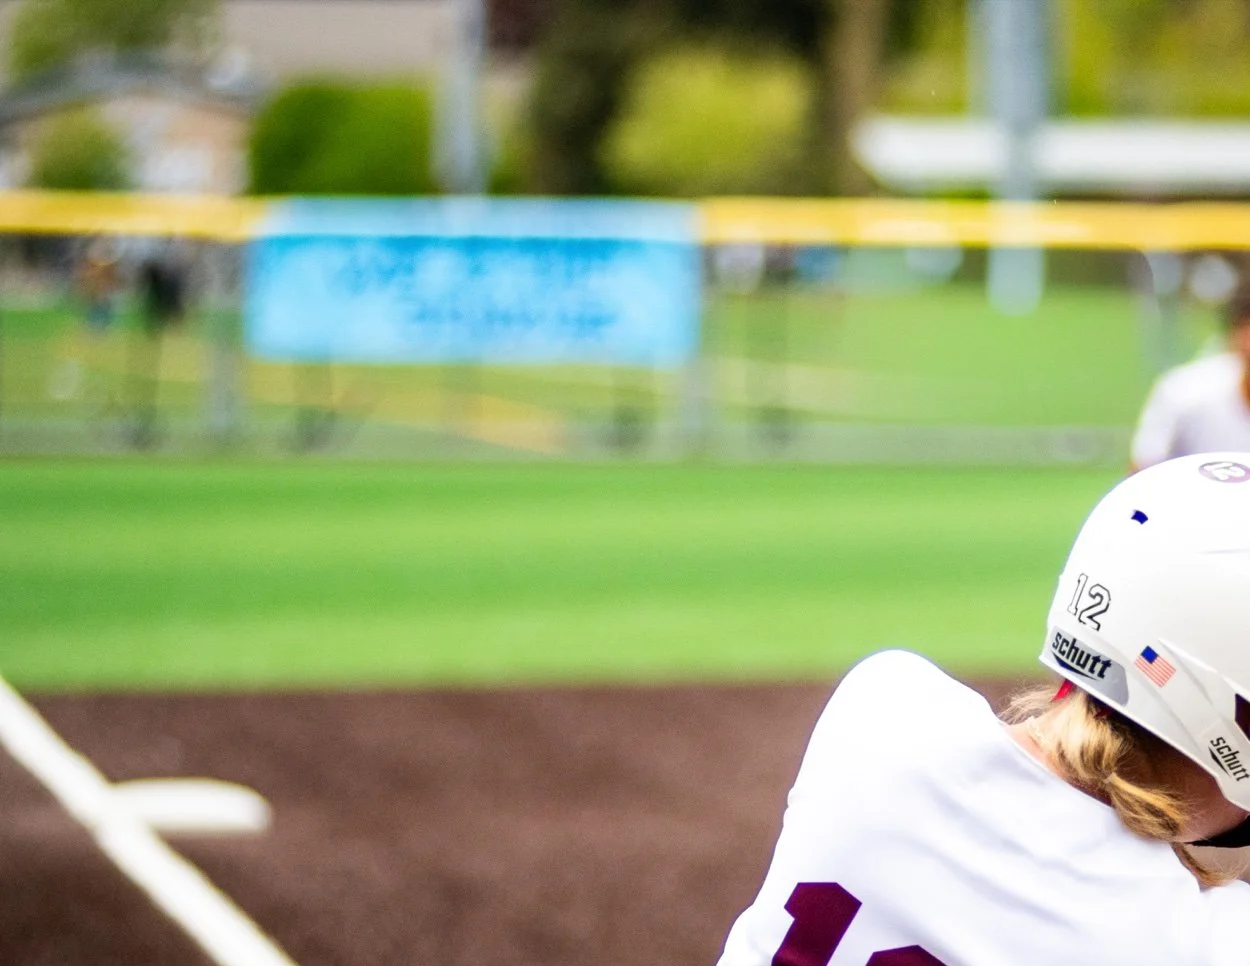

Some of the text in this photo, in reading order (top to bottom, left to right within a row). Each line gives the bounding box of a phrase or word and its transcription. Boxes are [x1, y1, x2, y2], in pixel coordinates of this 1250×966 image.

[1067, 573, 1111, 632] 12
[1052, 632, 1112, 679] schutt
[1210, 736, 1250, 781] schutt
